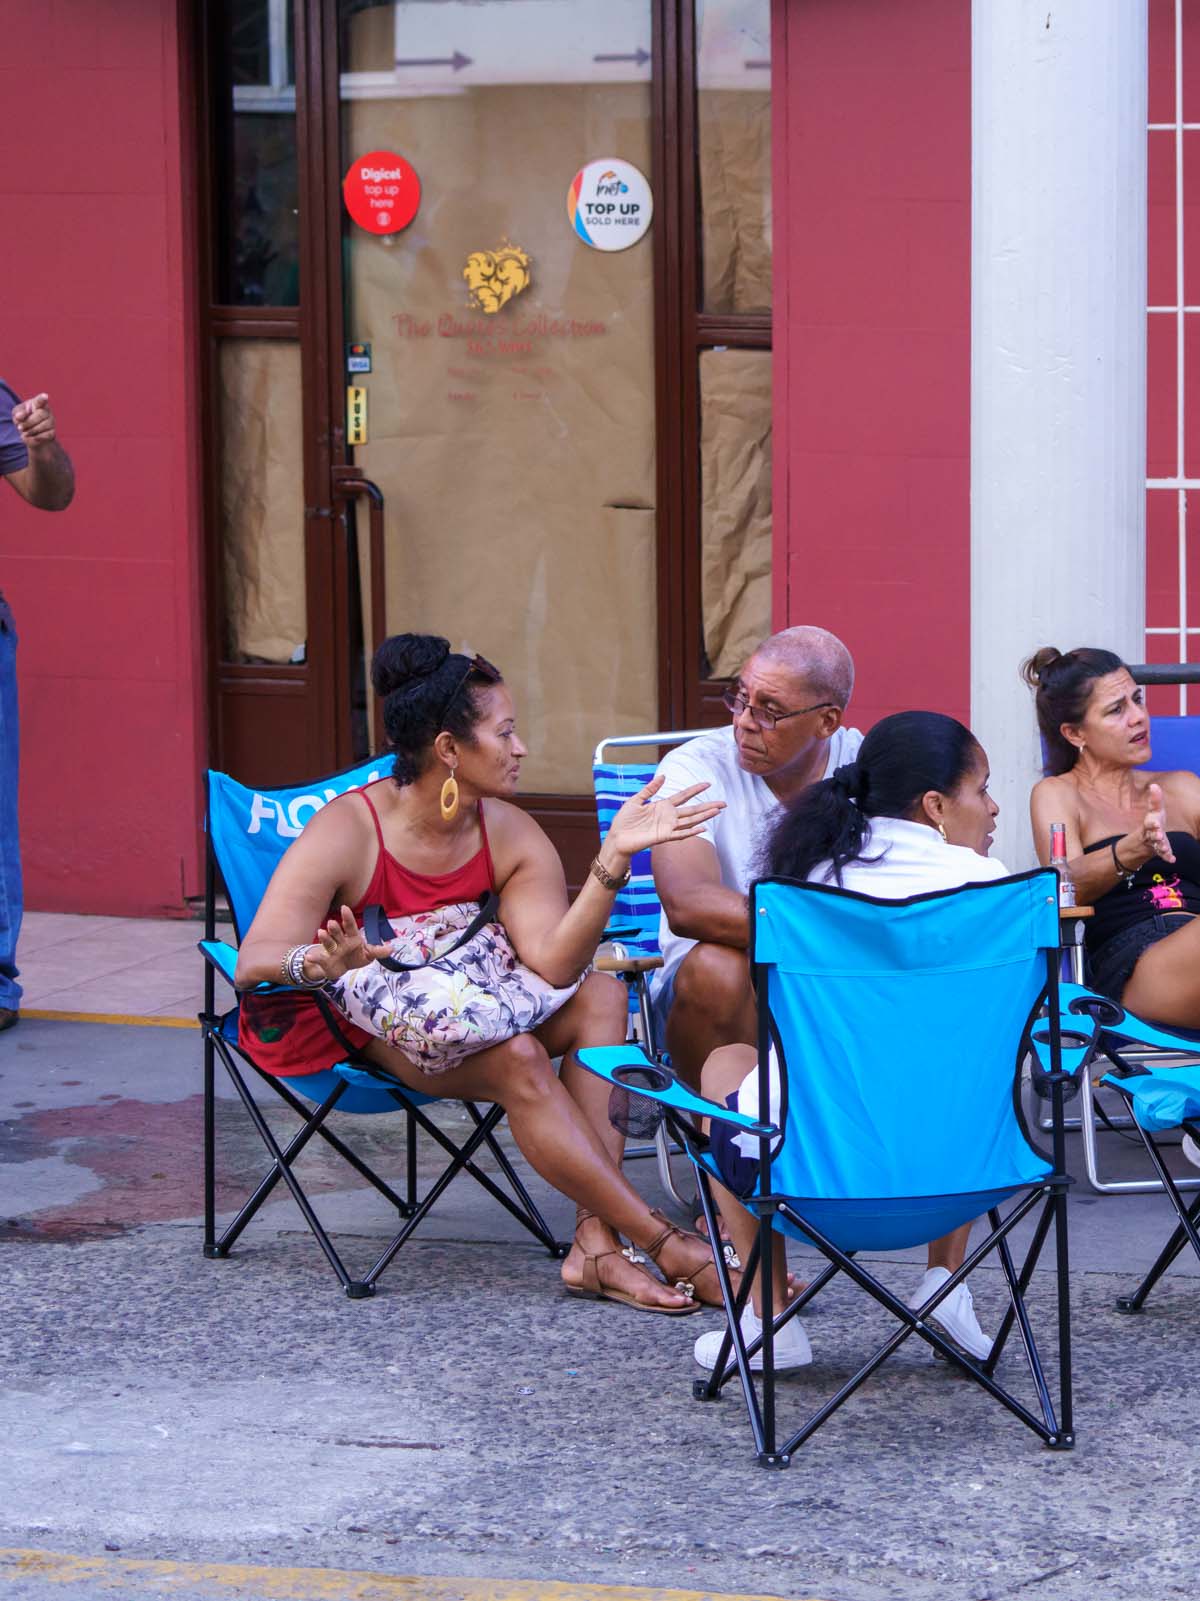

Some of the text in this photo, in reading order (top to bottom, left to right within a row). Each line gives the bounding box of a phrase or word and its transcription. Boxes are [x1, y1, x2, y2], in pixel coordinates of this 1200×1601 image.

[361, 167, 402, 183] Digicel
[364, 185, 400, 197] top up
[369, 198, 395, 208] here
[585, 203, 640, 215] TOP UP
[585, 217, 640, 226] SOLD HERE
[353, 388, 362, 442] PUSH
